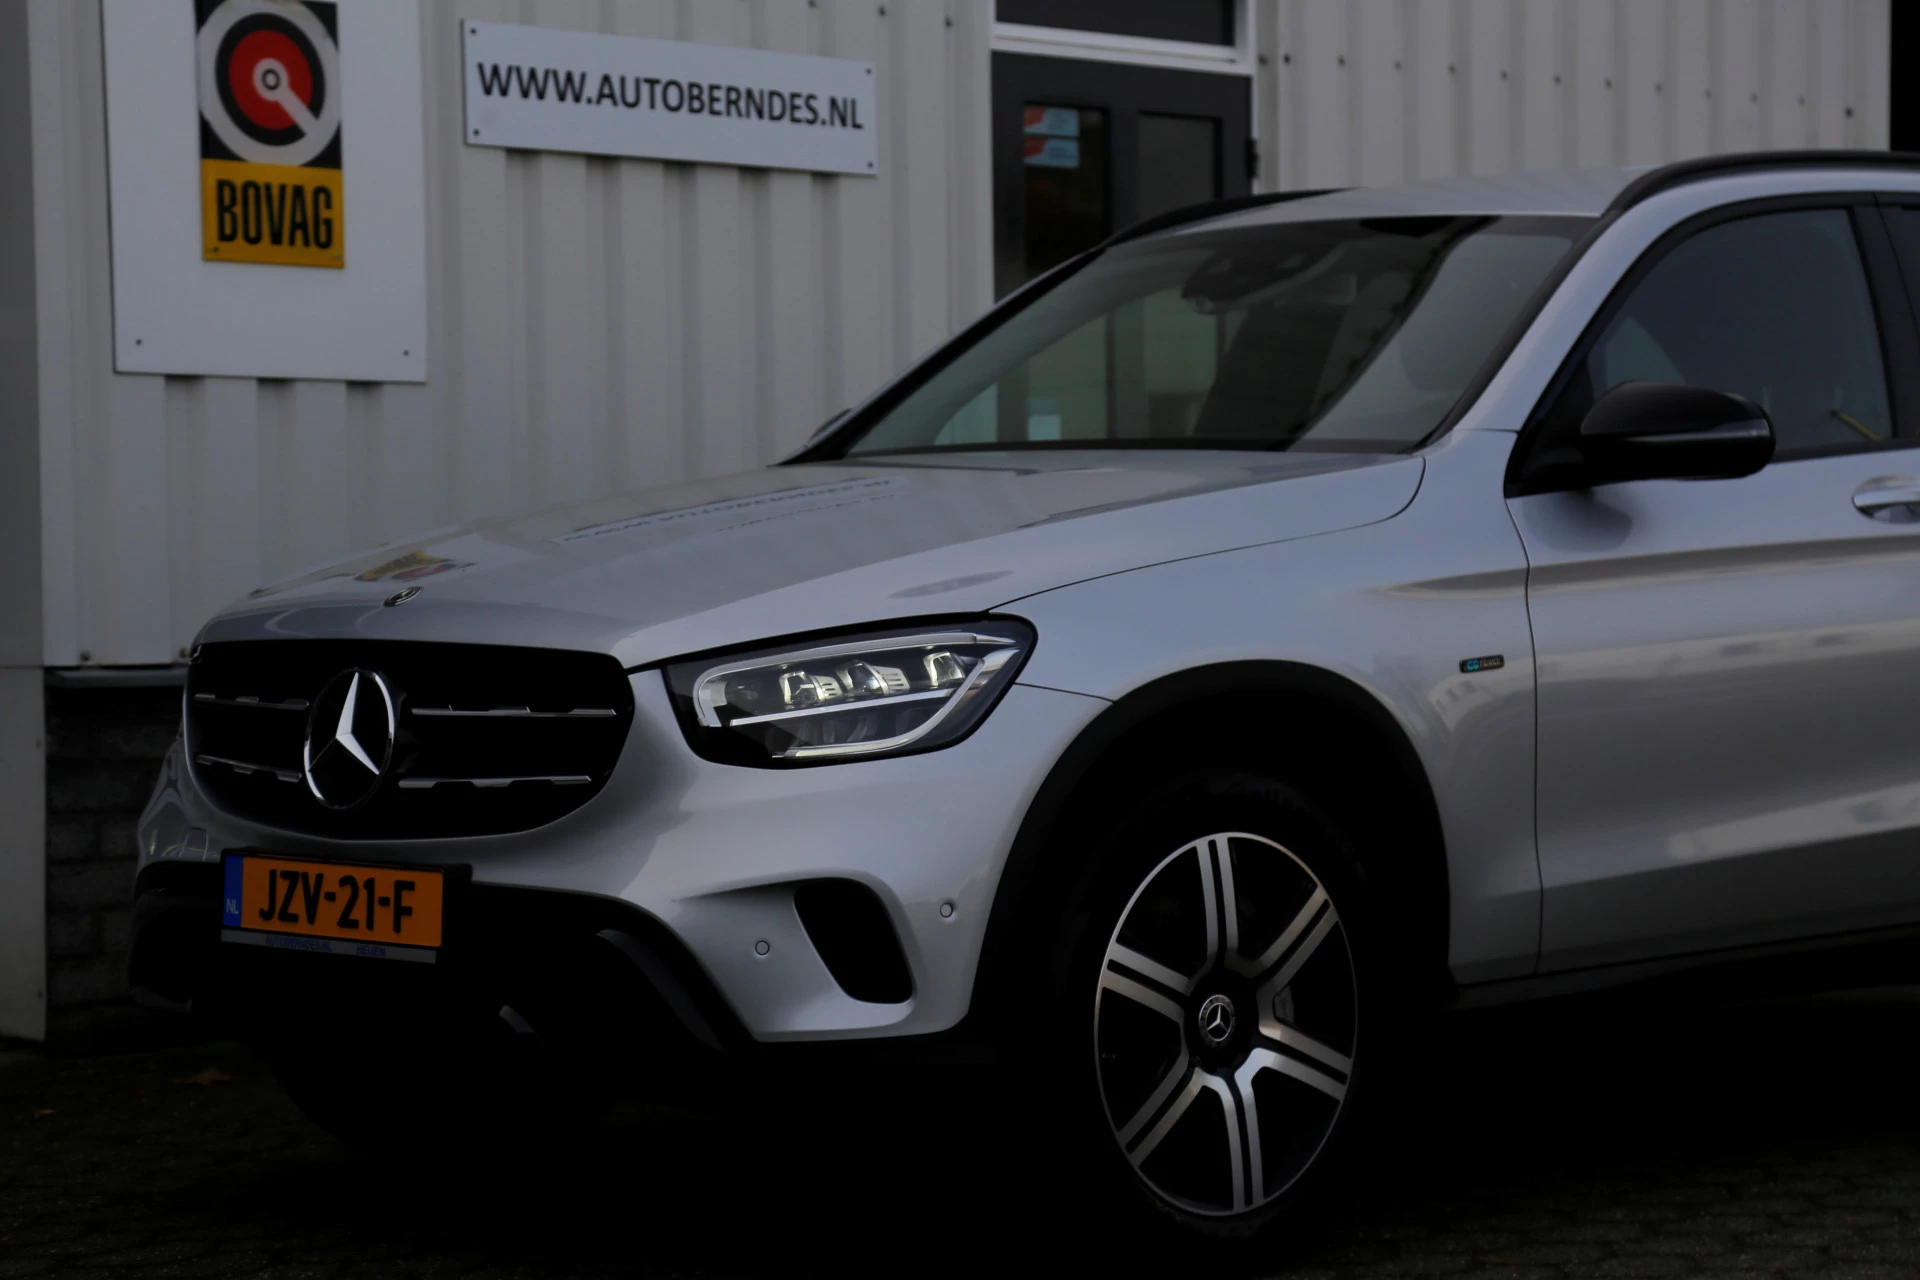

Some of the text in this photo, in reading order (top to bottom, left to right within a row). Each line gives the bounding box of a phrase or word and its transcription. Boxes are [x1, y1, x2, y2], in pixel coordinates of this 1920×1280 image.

[477, 62, 864, 130] WWW.AUTOBERNDES.NL
[216, 179, 333, 250] BOVAG
[226, 897, 240, 915] NL
[259, 868, 416, 934] JZV-21-F
